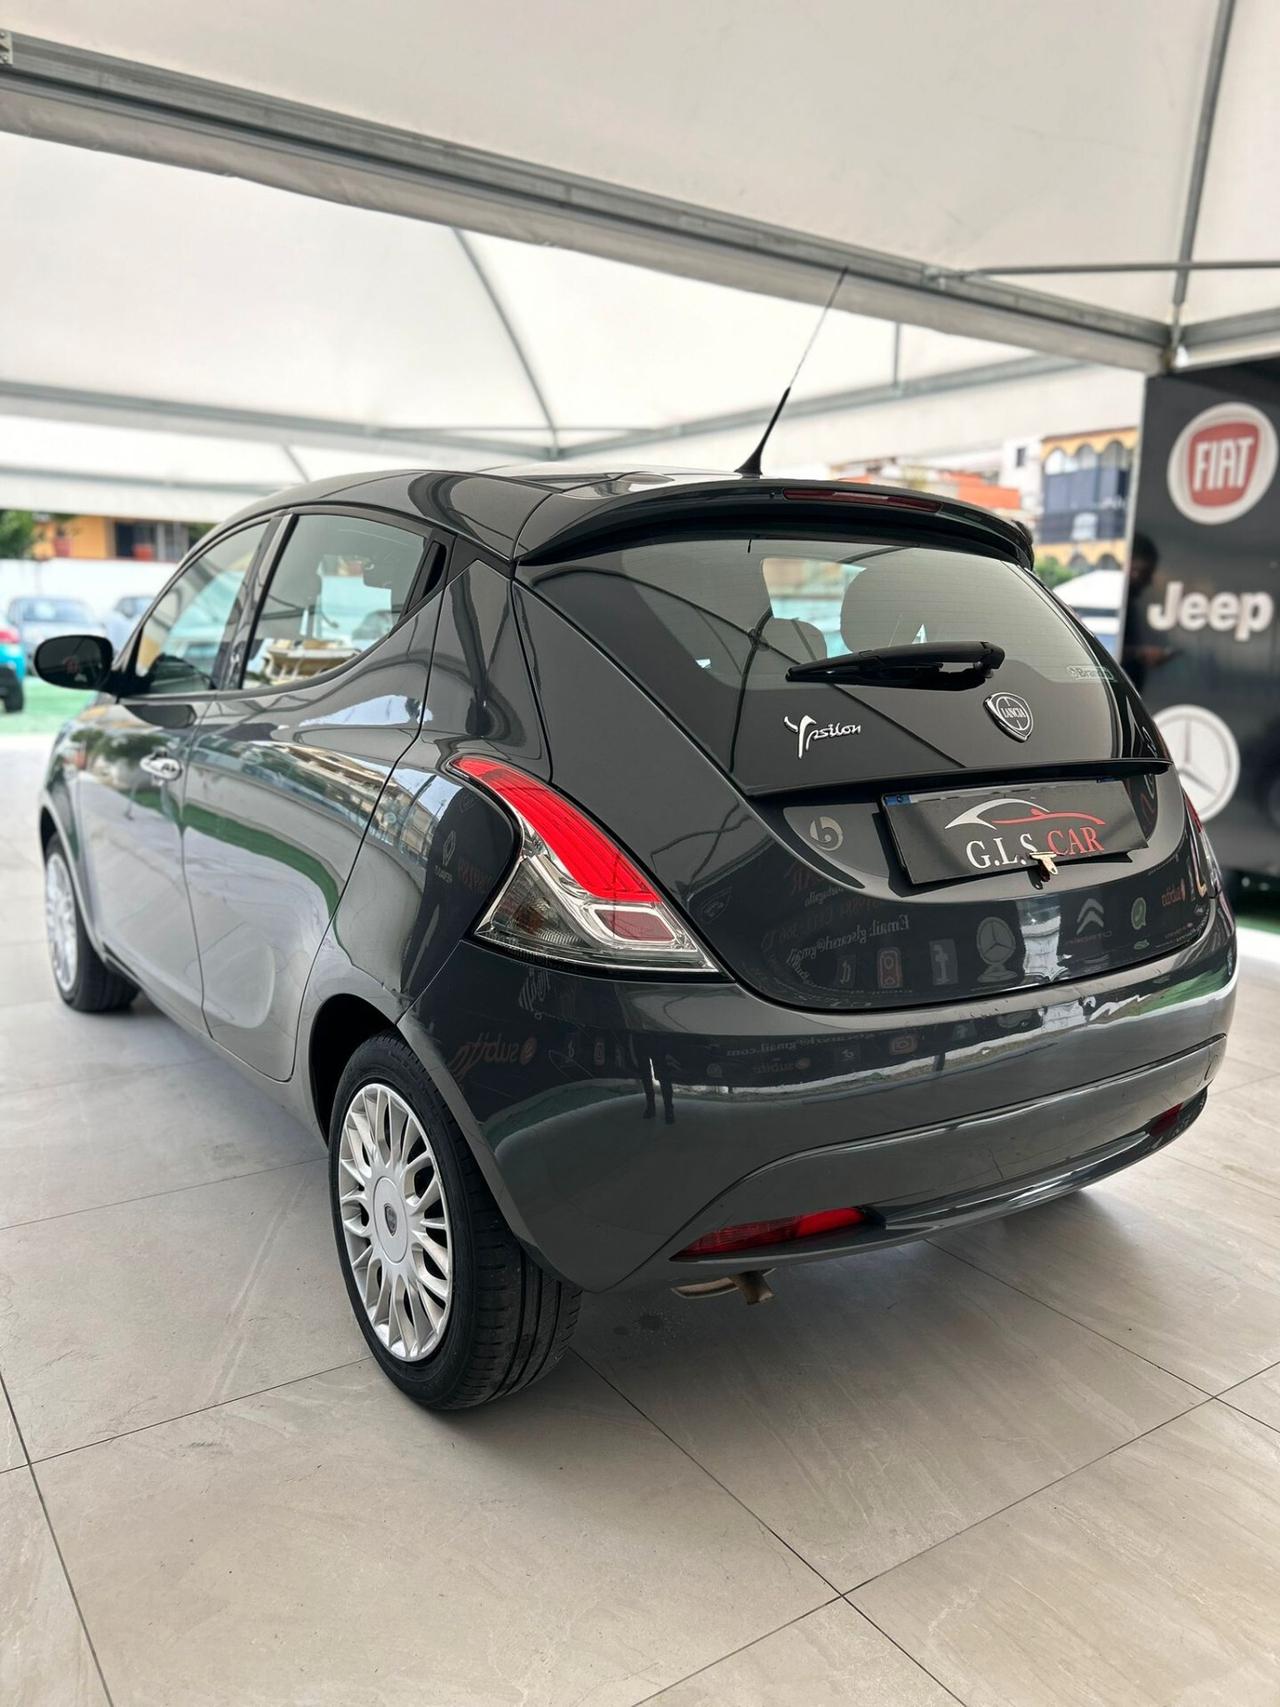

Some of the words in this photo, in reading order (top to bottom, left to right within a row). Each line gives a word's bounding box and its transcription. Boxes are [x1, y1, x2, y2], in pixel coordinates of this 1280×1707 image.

[1193, 437, 1255, 491] FIAT
[1147, 580, 1274, 641] Jeep
[999, 707, 1026, 719] LANCIA
[783, 715, 862, 759] Ypsilon
[1047, 826, 1105, 857] CAR
